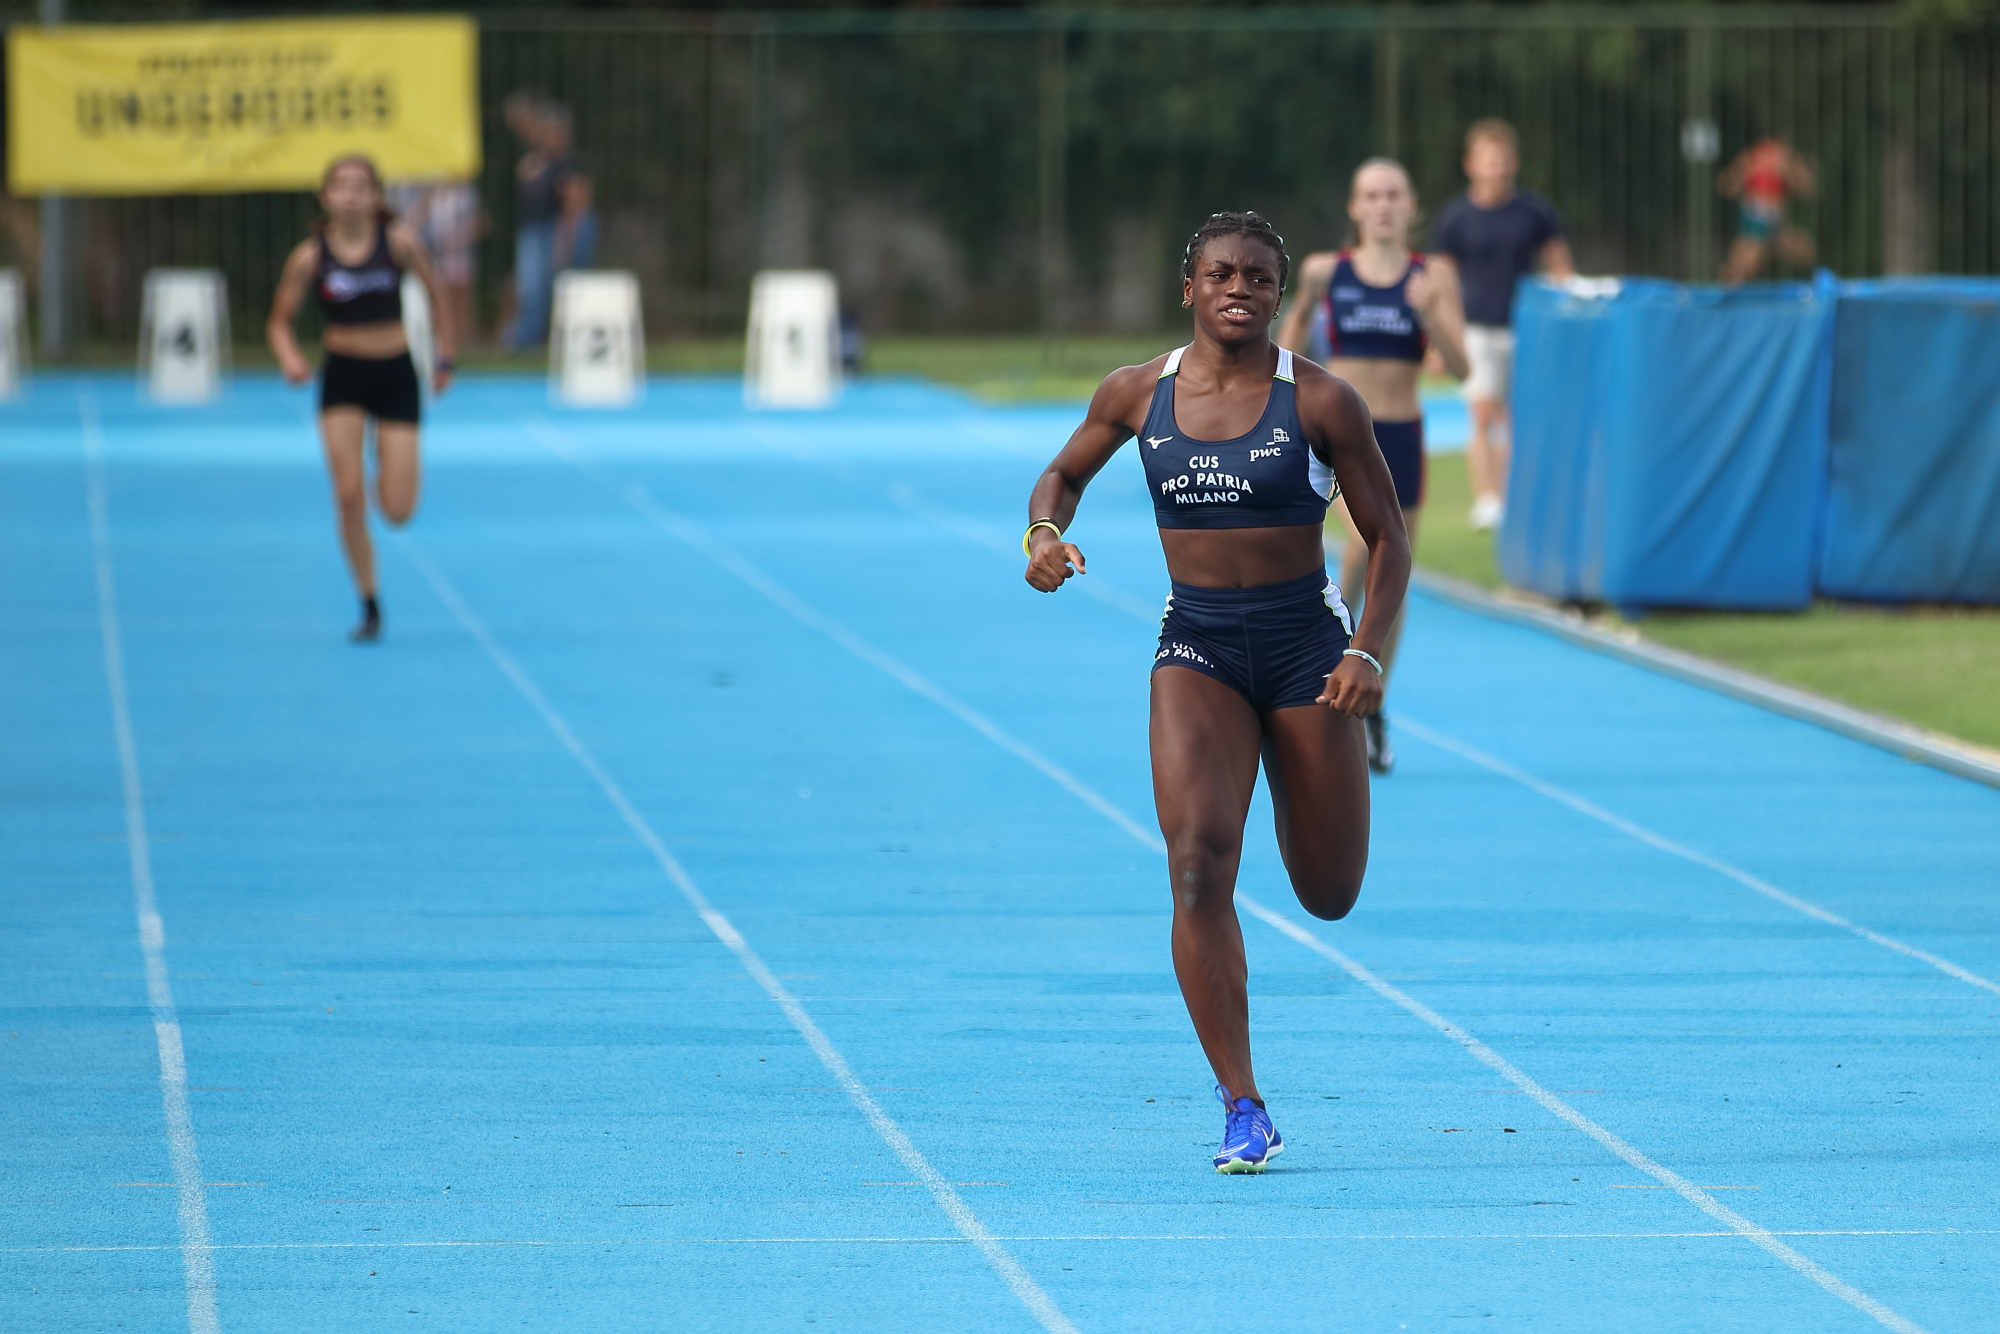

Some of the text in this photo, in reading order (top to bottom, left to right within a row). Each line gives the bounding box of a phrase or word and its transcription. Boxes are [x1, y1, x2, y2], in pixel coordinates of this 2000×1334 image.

[1249, 446, 1282, 462] pwc
[1188, 455, 1219, 469] CUS
[1161, 472, 1254, 496] PRO PATRIA
[1175, 491, 1240, 504] MILANO
